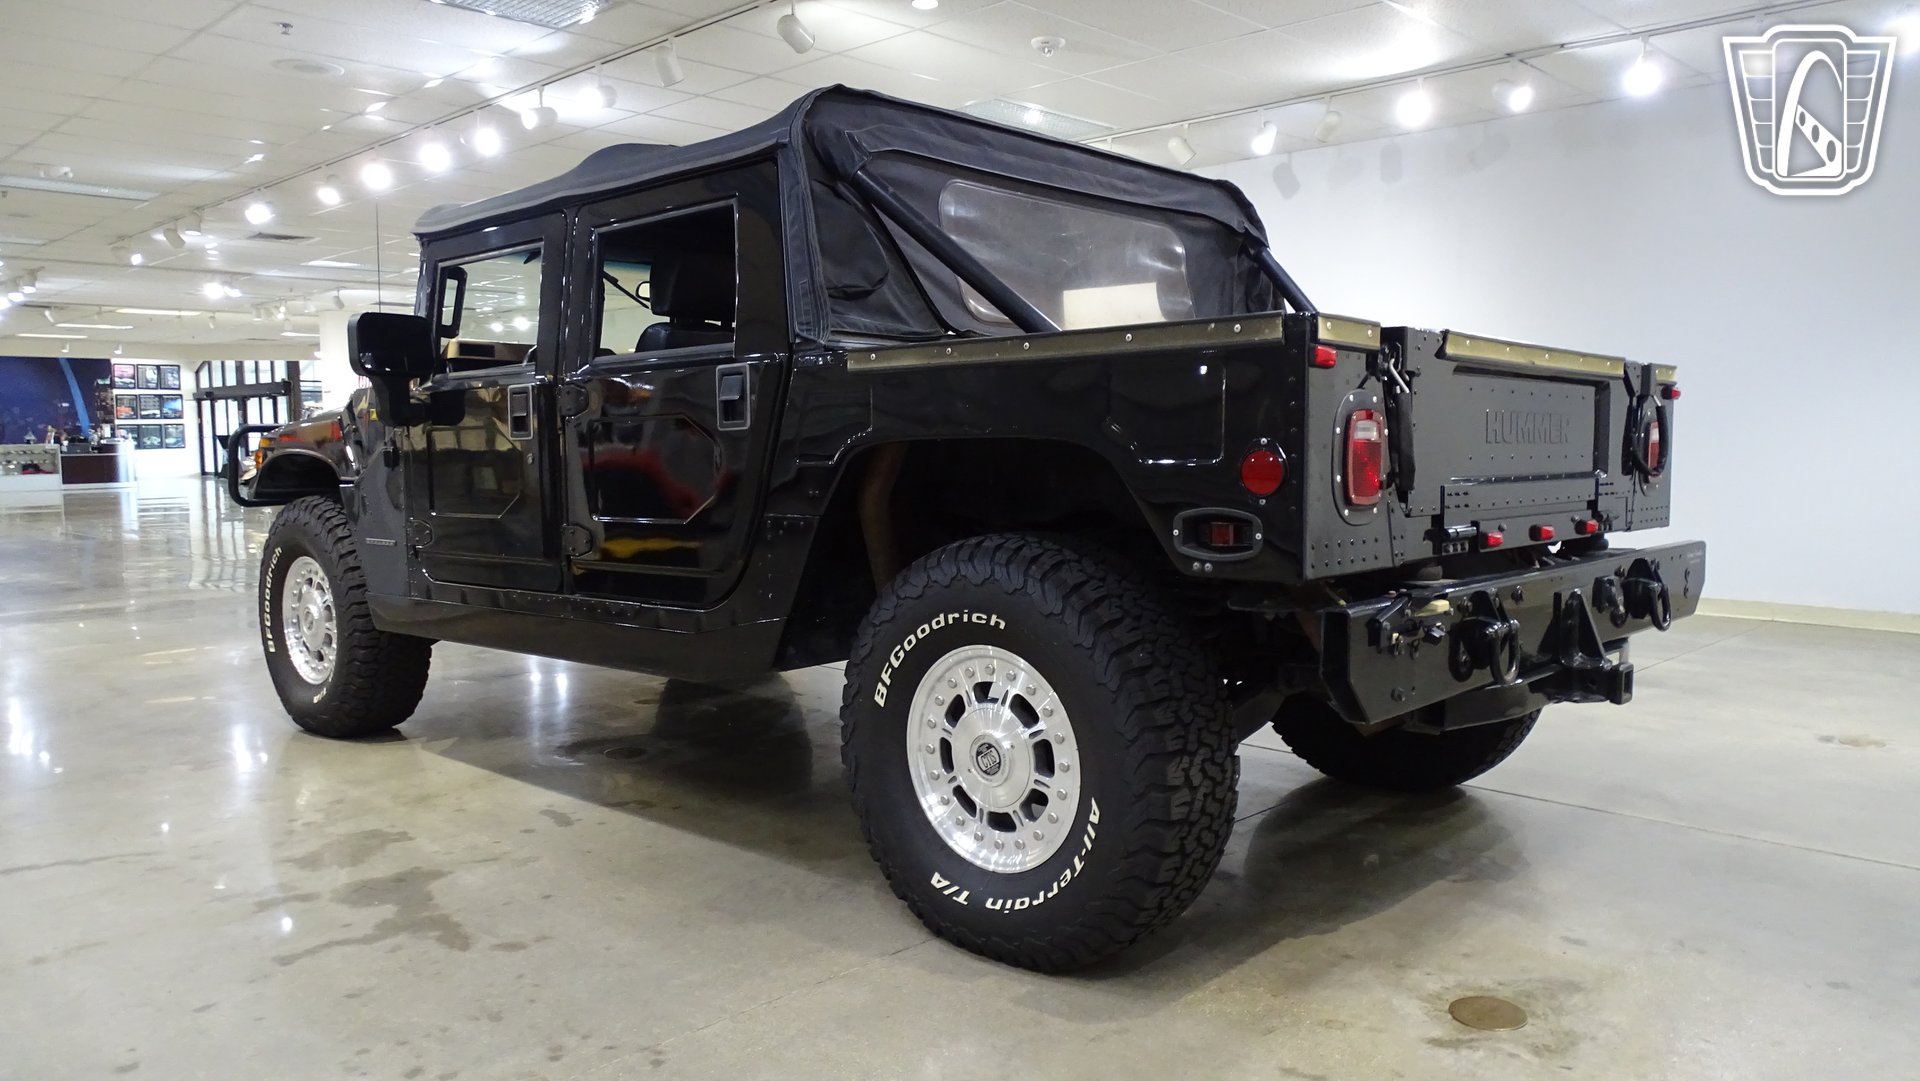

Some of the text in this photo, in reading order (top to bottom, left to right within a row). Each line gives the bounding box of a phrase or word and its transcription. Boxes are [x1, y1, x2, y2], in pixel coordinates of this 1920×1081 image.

[1485, 408, 1570, 444] HUMMER
[264, 546, 283, 653] BFGoodrich
[873, 609, 1007, 708] BFGoodrich
[930, 796, 1100, 914] All-Terrain T/A
